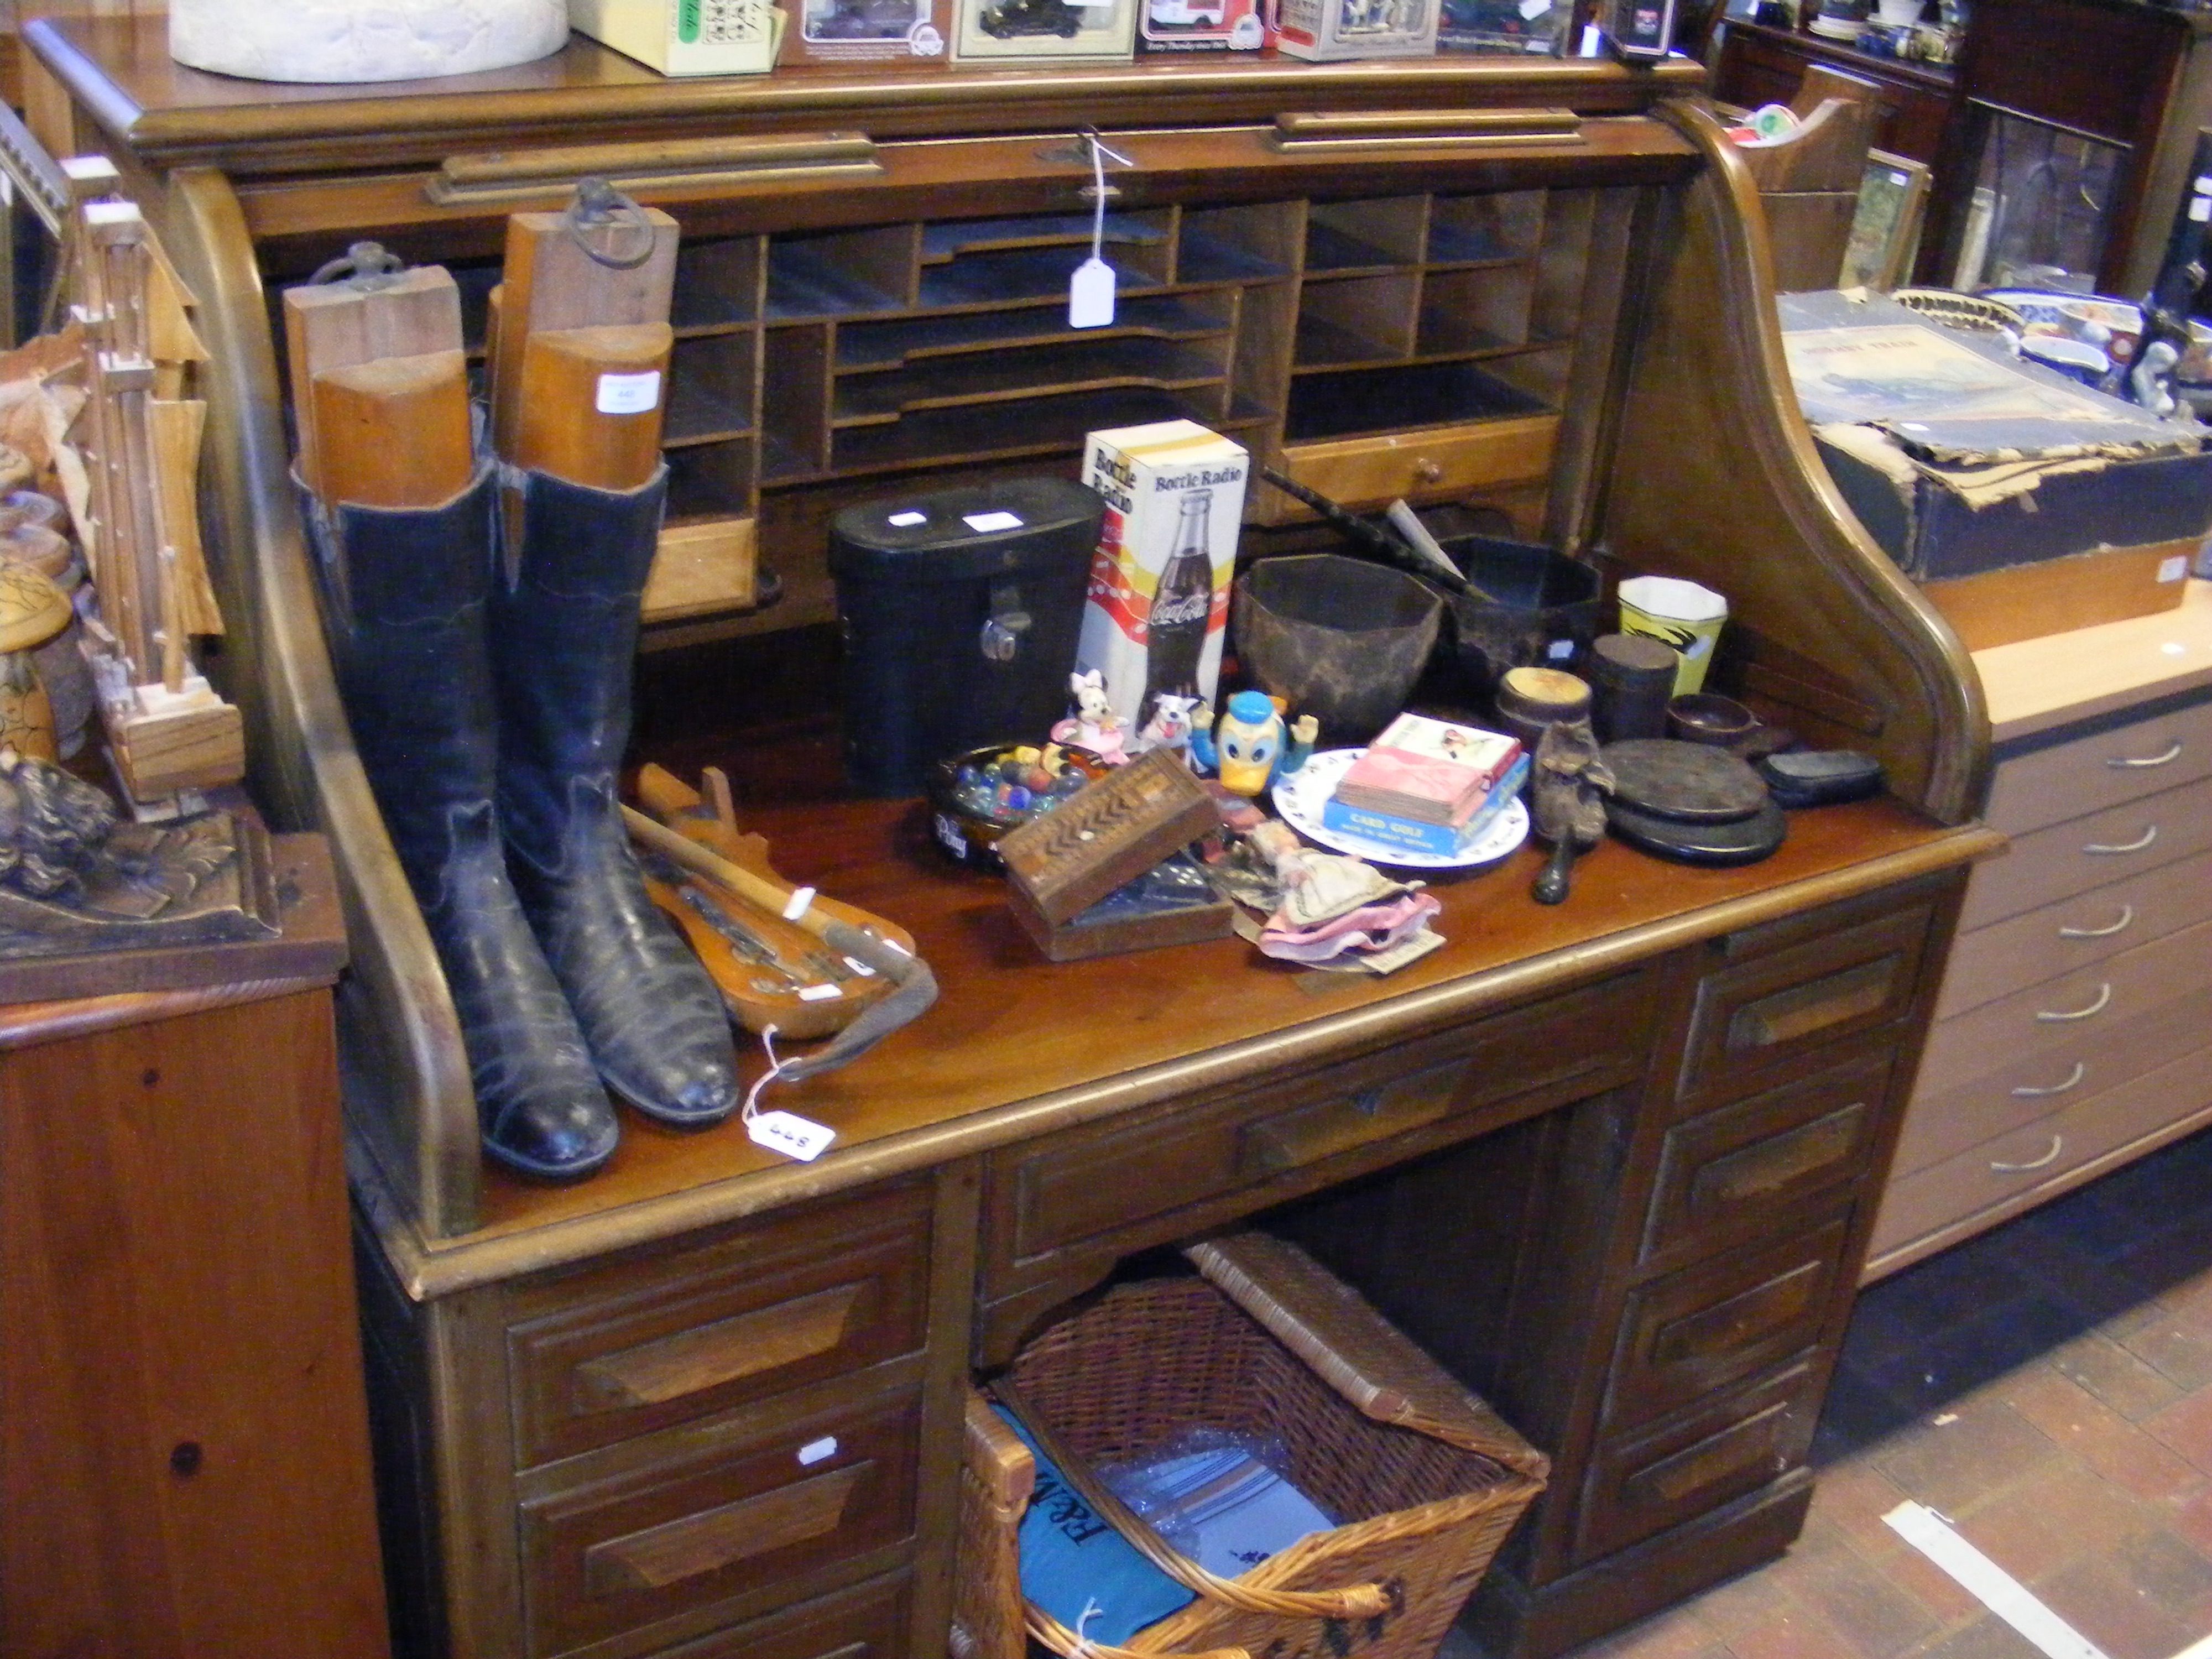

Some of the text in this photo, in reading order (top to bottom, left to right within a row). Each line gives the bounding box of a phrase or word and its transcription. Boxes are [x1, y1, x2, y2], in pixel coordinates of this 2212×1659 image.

[1095, 447, 1137, 491] Bottle
[1155, 466, 1243, 492] Bottle Radio
[1092, 473, 1134, 514] Radio
